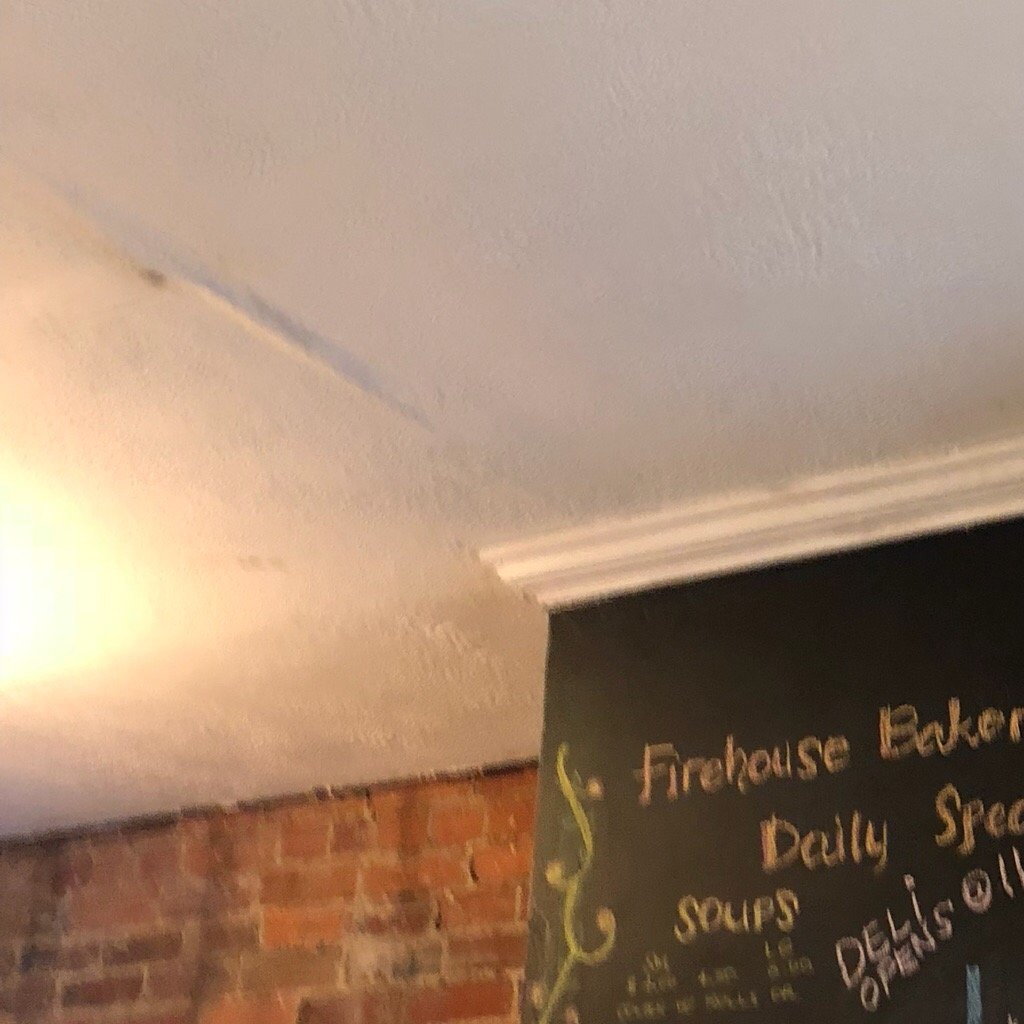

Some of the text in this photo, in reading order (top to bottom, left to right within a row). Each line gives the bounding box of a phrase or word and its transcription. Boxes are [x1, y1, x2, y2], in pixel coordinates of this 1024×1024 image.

[633, 734, 852, 806] Firehouse
[760, 810, 889, 876] Daily
[674, 888, 799, 946] SOUPS
